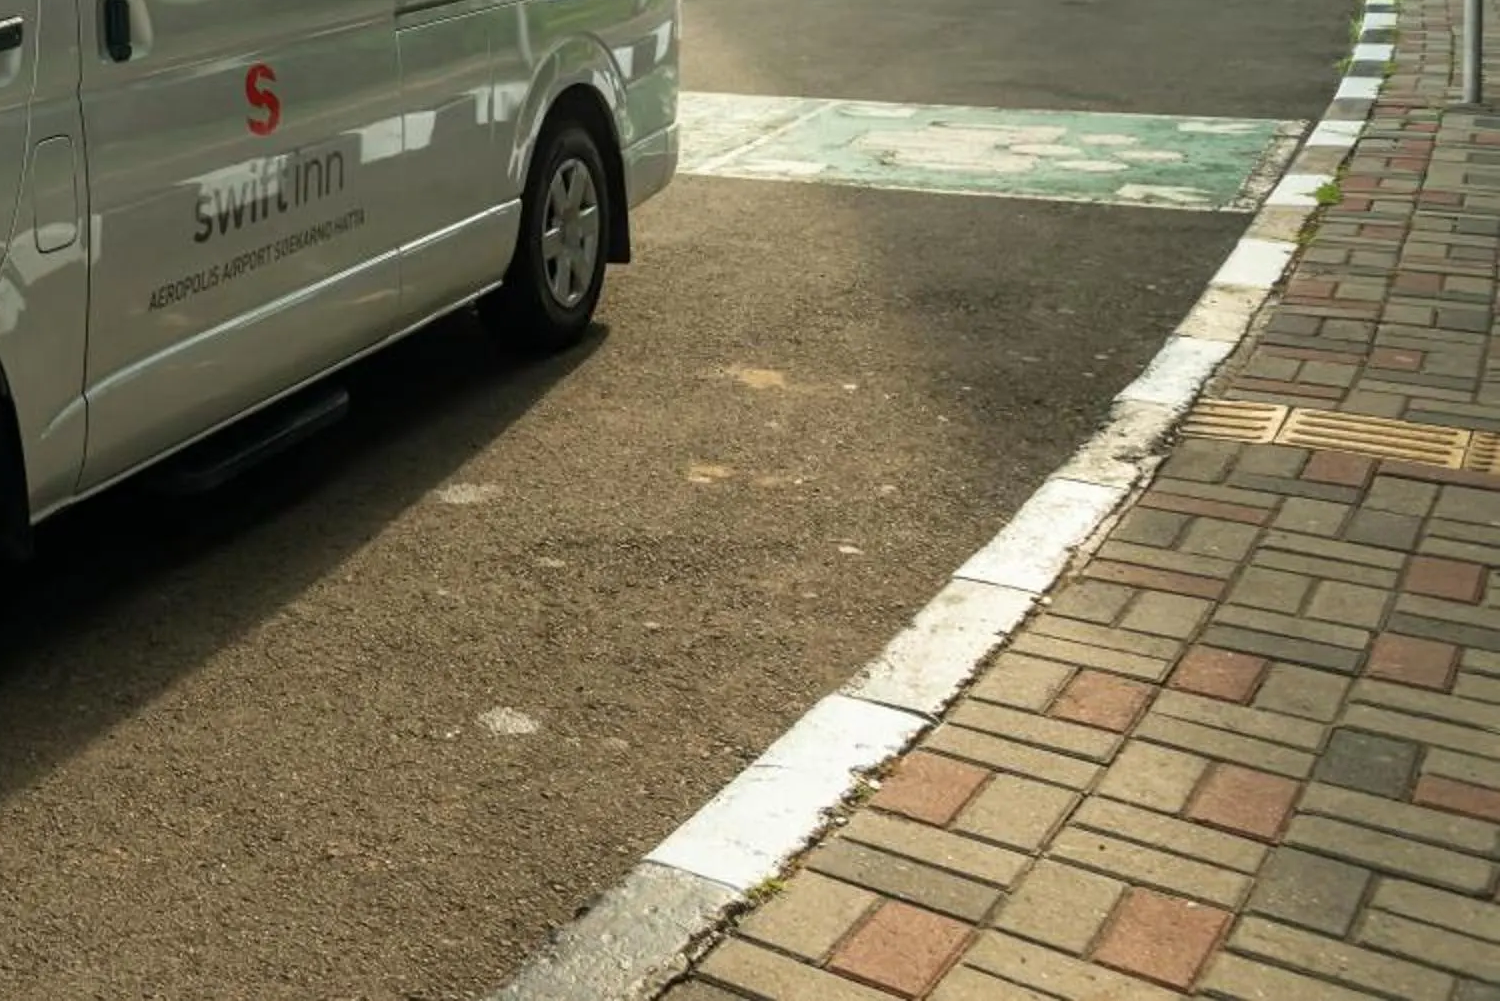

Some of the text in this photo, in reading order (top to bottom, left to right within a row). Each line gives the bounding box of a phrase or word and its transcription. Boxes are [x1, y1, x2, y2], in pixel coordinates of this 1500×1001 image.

[245, 64, 280, 136] S
[194, 148, 343, 243] swift inn
[148, 264, 219, 311] AEROPOLIS
[221, 244, 273, 282] AIRPORT
